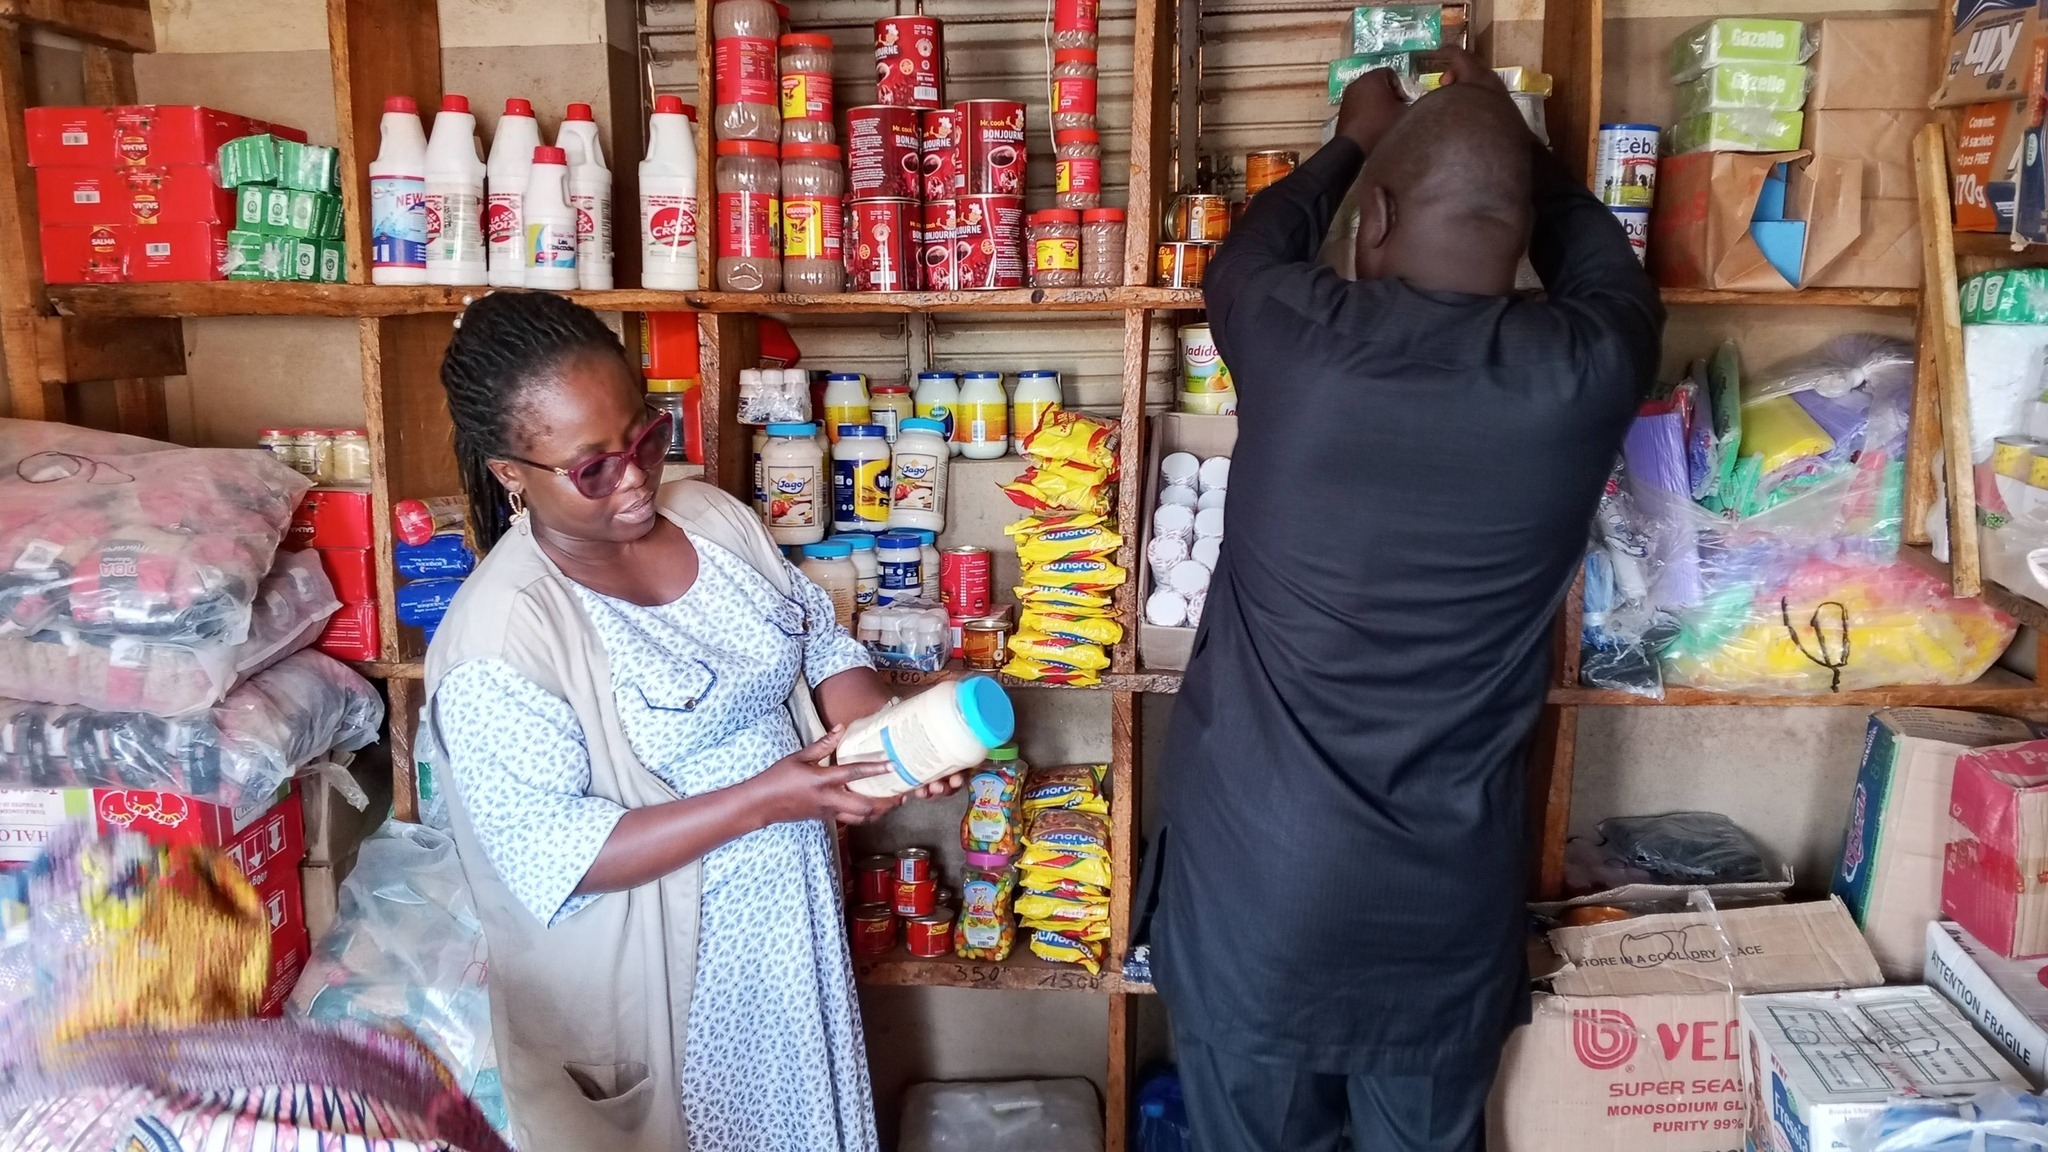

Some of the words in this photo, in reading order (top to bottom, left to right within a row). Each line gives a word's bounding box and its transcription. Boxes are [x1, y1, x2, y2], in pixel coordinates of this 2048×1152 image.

[983, 129, 1024, 141] BONJOURNE
[397, 193, 424, 208] NEW
[652, 225, 696, 237] CROIX
[904, 466, 925, 477] Jago
[780, 480, 803, 491] Jago
[1038, 528, 1103, 541] Bonjourne
[1042, 562, 1106, 572] Bonjourne
[857, 591, 874, 601] ago
[1581, 956, 1616, 969] TORE
[1620, 955, 1634, 966] IN
[1636, 954, 1647, 964] A
[1690, 949, 1717, 961] DRY
[1931, 950, 1982, 1016] ATTENTION
[1984, 1009, 2031, 1067] FRAGILE
[1609, 1080, 1686, 1099] SUPER
[1606, 1101, 1718, 1117] MONOSODIUM
[1723, 1100, 1747, 1112] GL
[1652, 1119, 1709, 1133] PURITY
[1713, 1118, 1744, 1130] 99%
